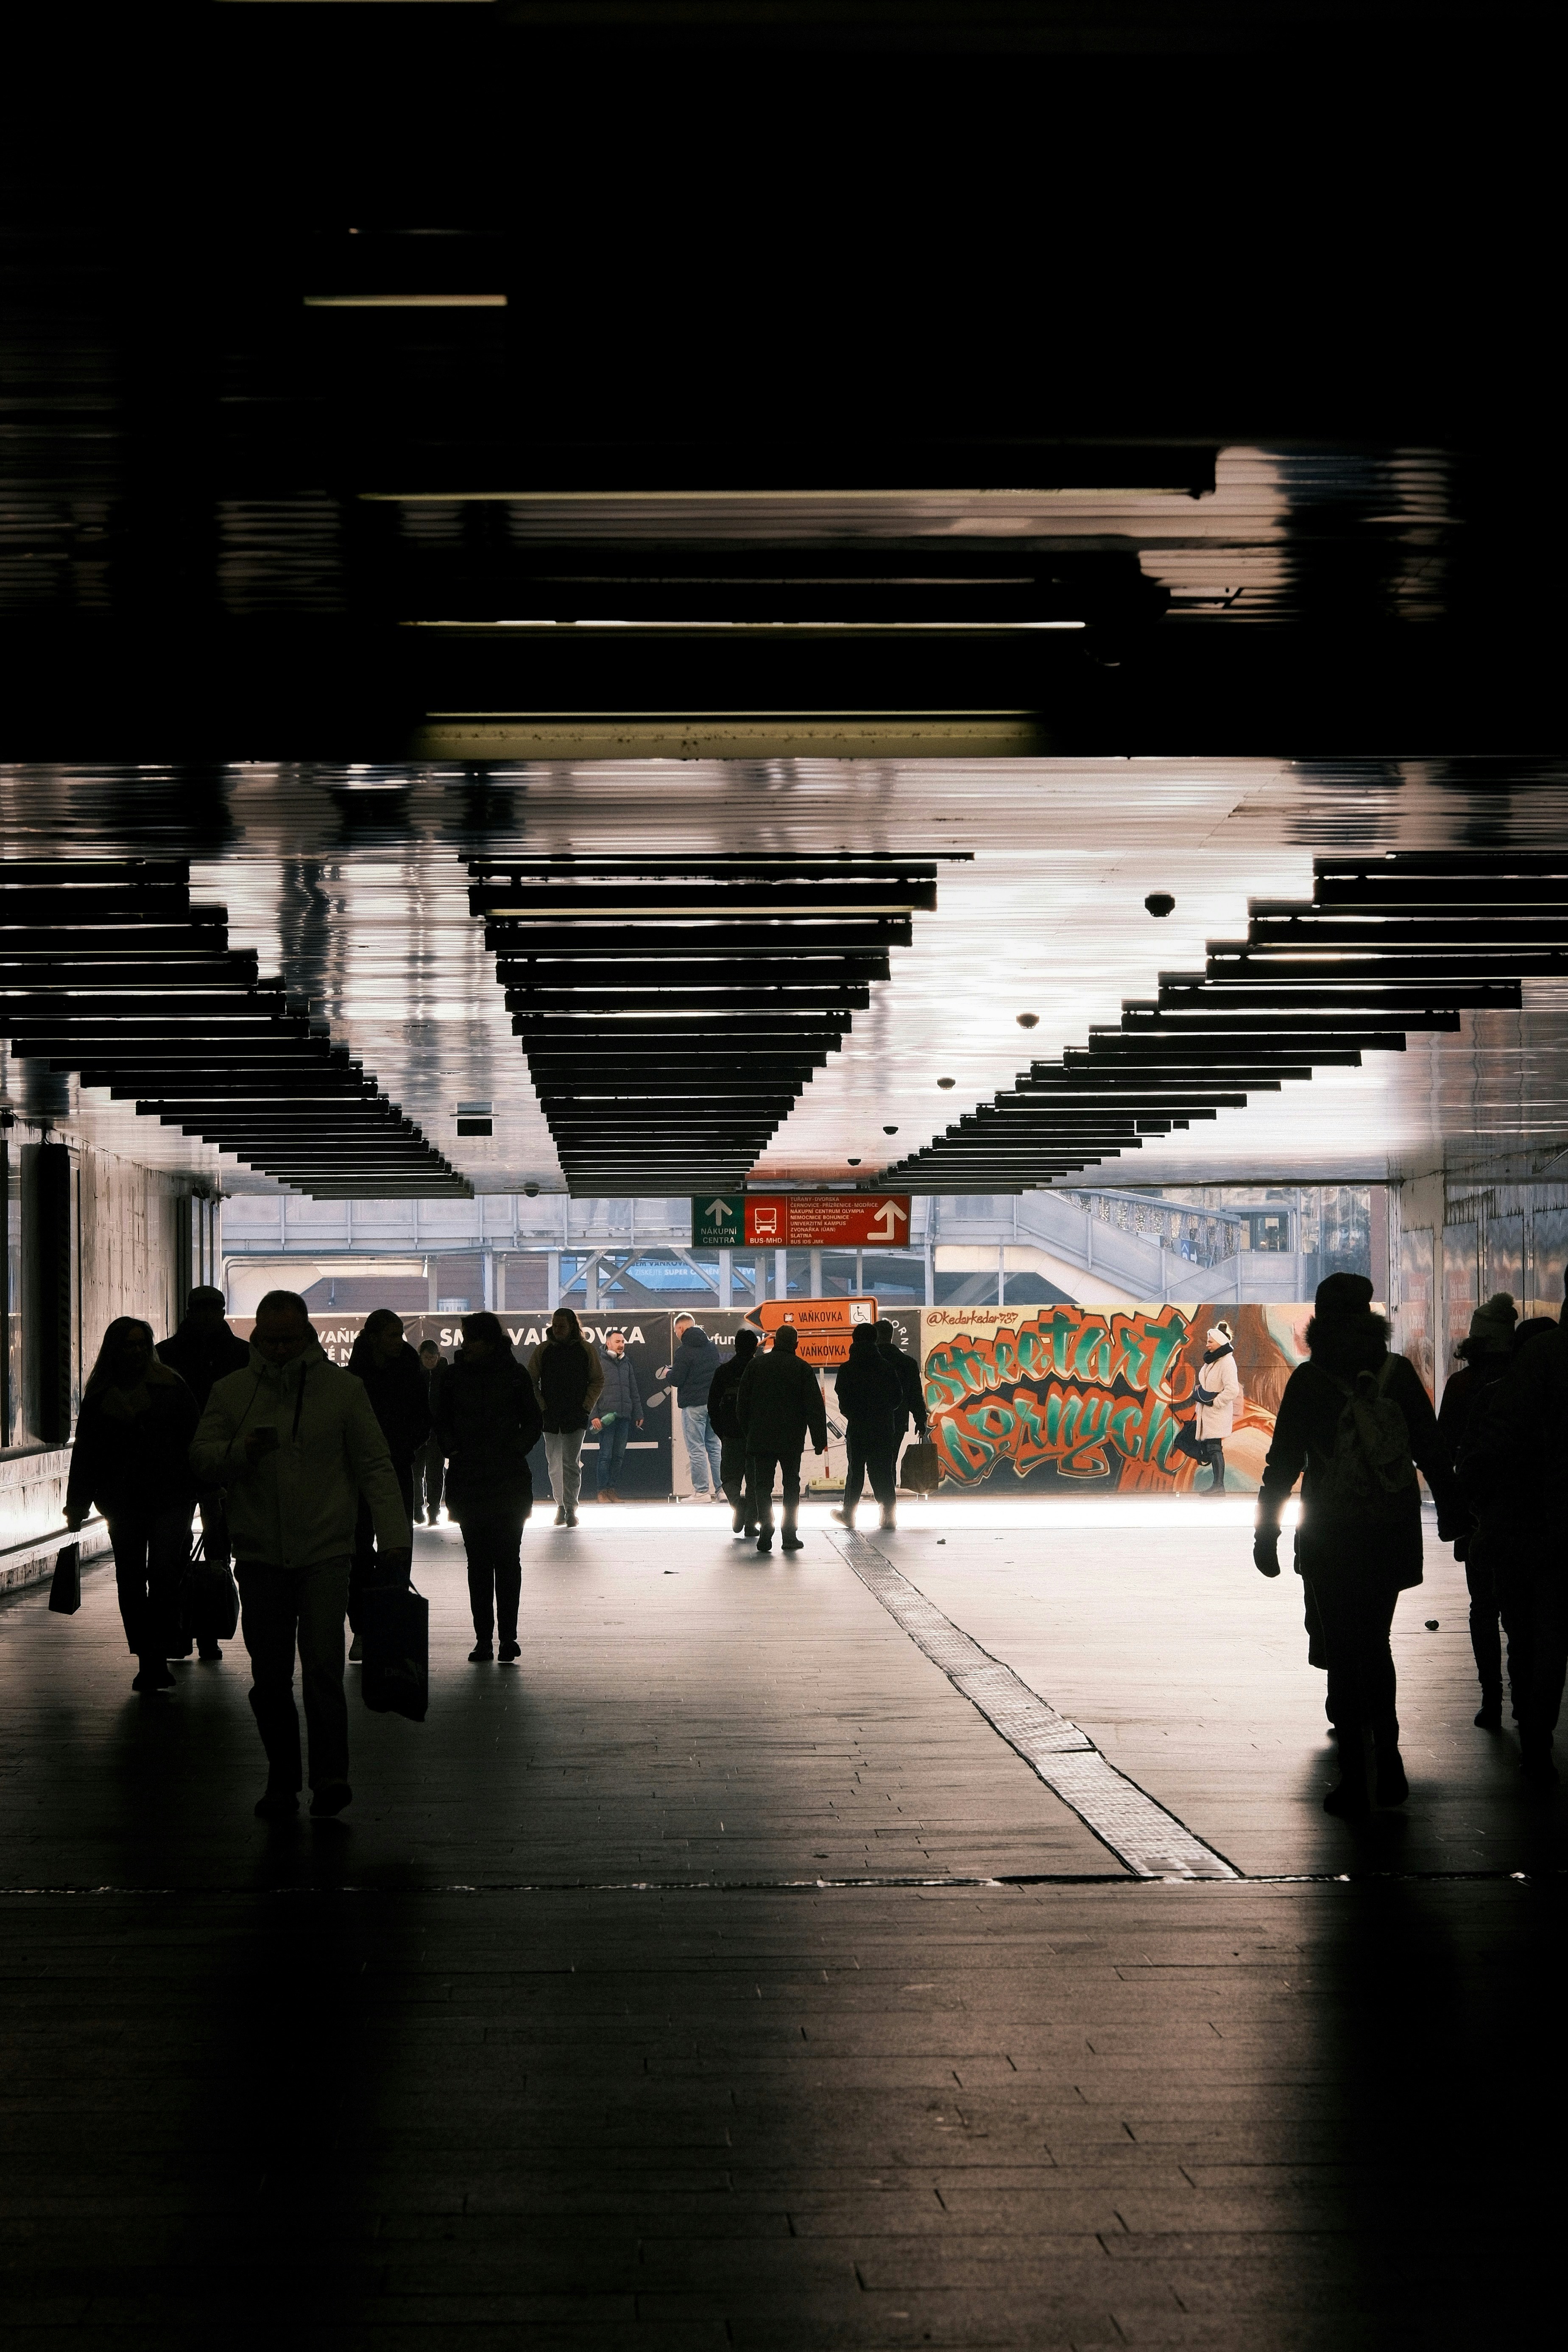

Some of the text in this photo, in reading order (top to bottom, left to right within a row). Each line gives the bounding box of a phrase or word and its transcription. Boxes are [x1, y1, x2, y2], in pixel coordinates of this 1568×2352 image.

[700, 1226, 737, 1235] NÁKUPNÍ
[798, 1310, 843, 1322] VAŇKOVKA
[927, 1310, 1019, 1327] @kedarkedar737
[800, 1343, 846, 1357] VAŇKOVKA
